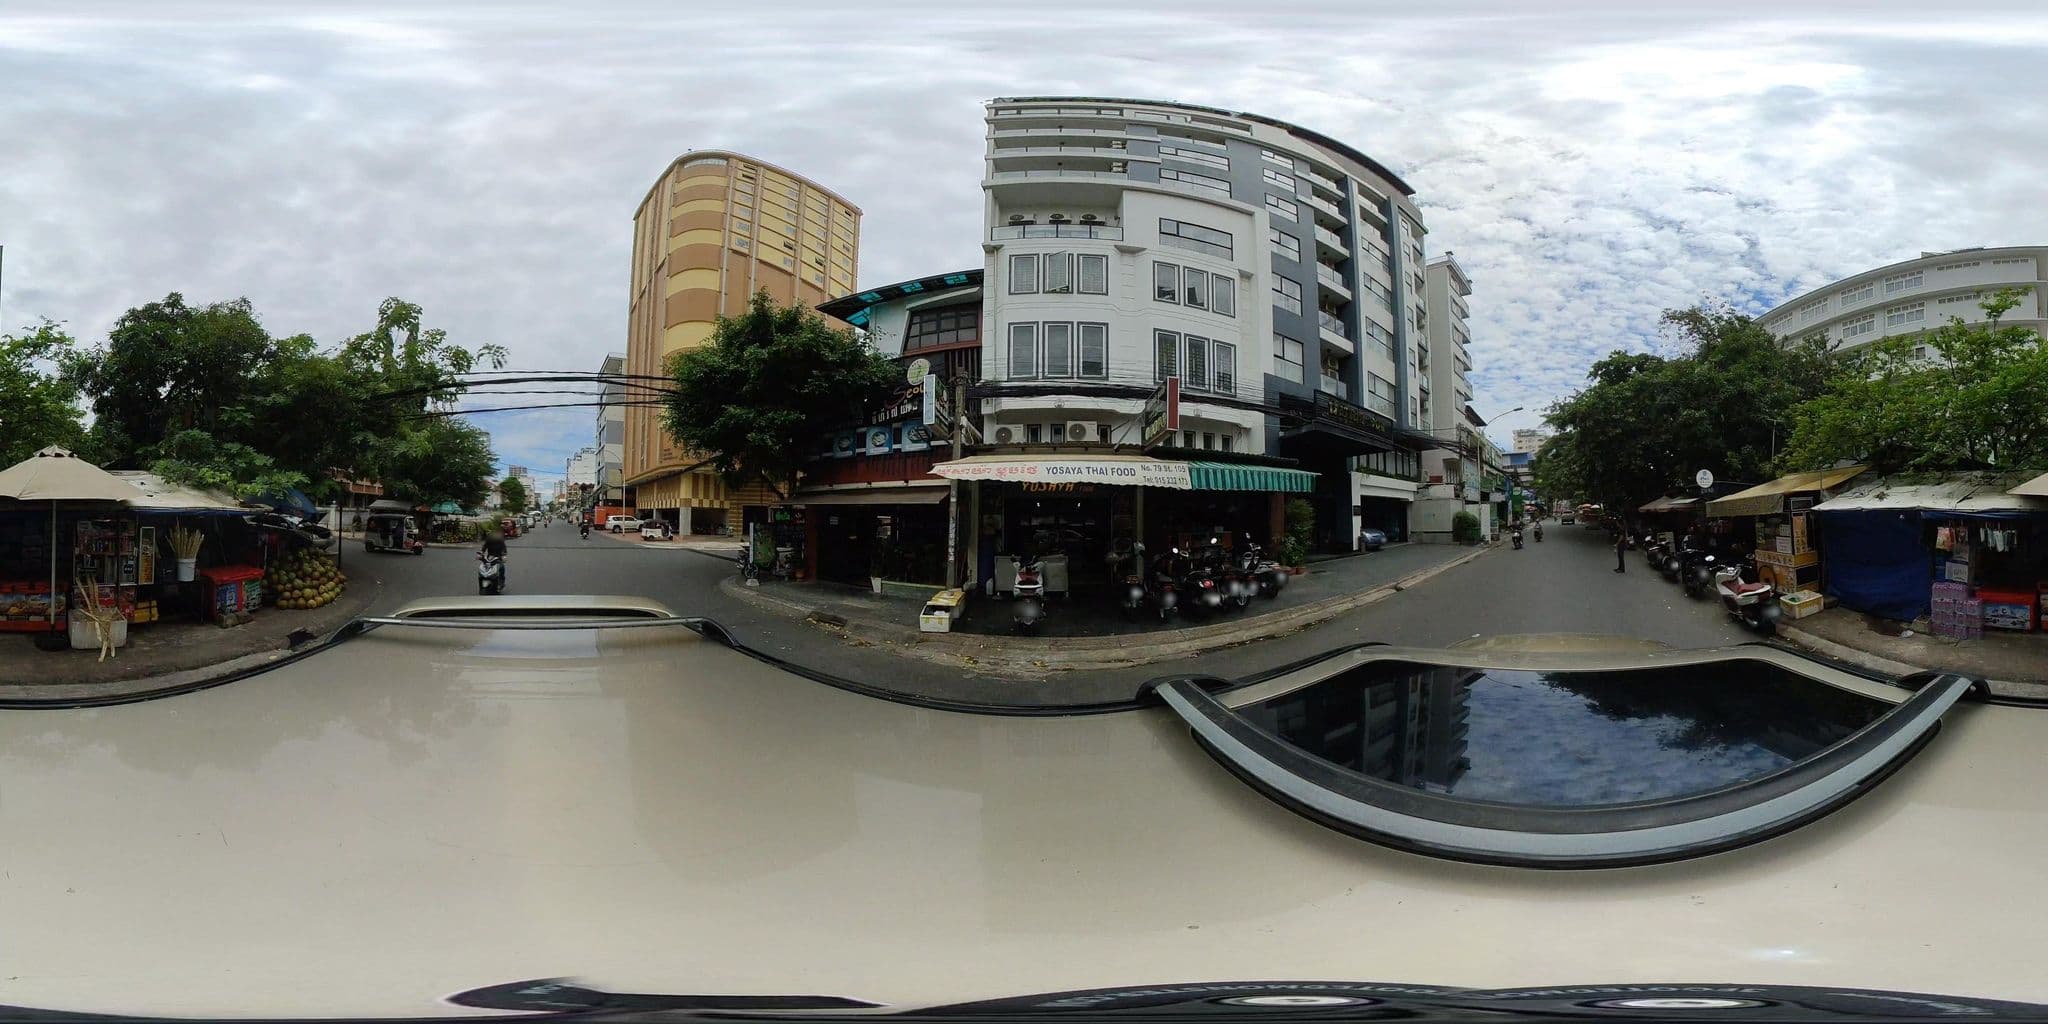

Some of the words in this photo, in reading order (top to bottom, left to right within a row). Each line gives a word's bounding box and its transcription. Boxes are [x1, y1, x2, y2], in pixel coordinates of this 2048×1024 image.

[1045, 466, 1083, 475] YOSAYA
[1086, 467, 1108, 476] THAI
[1111, 467, 1136, 477] FOOD
